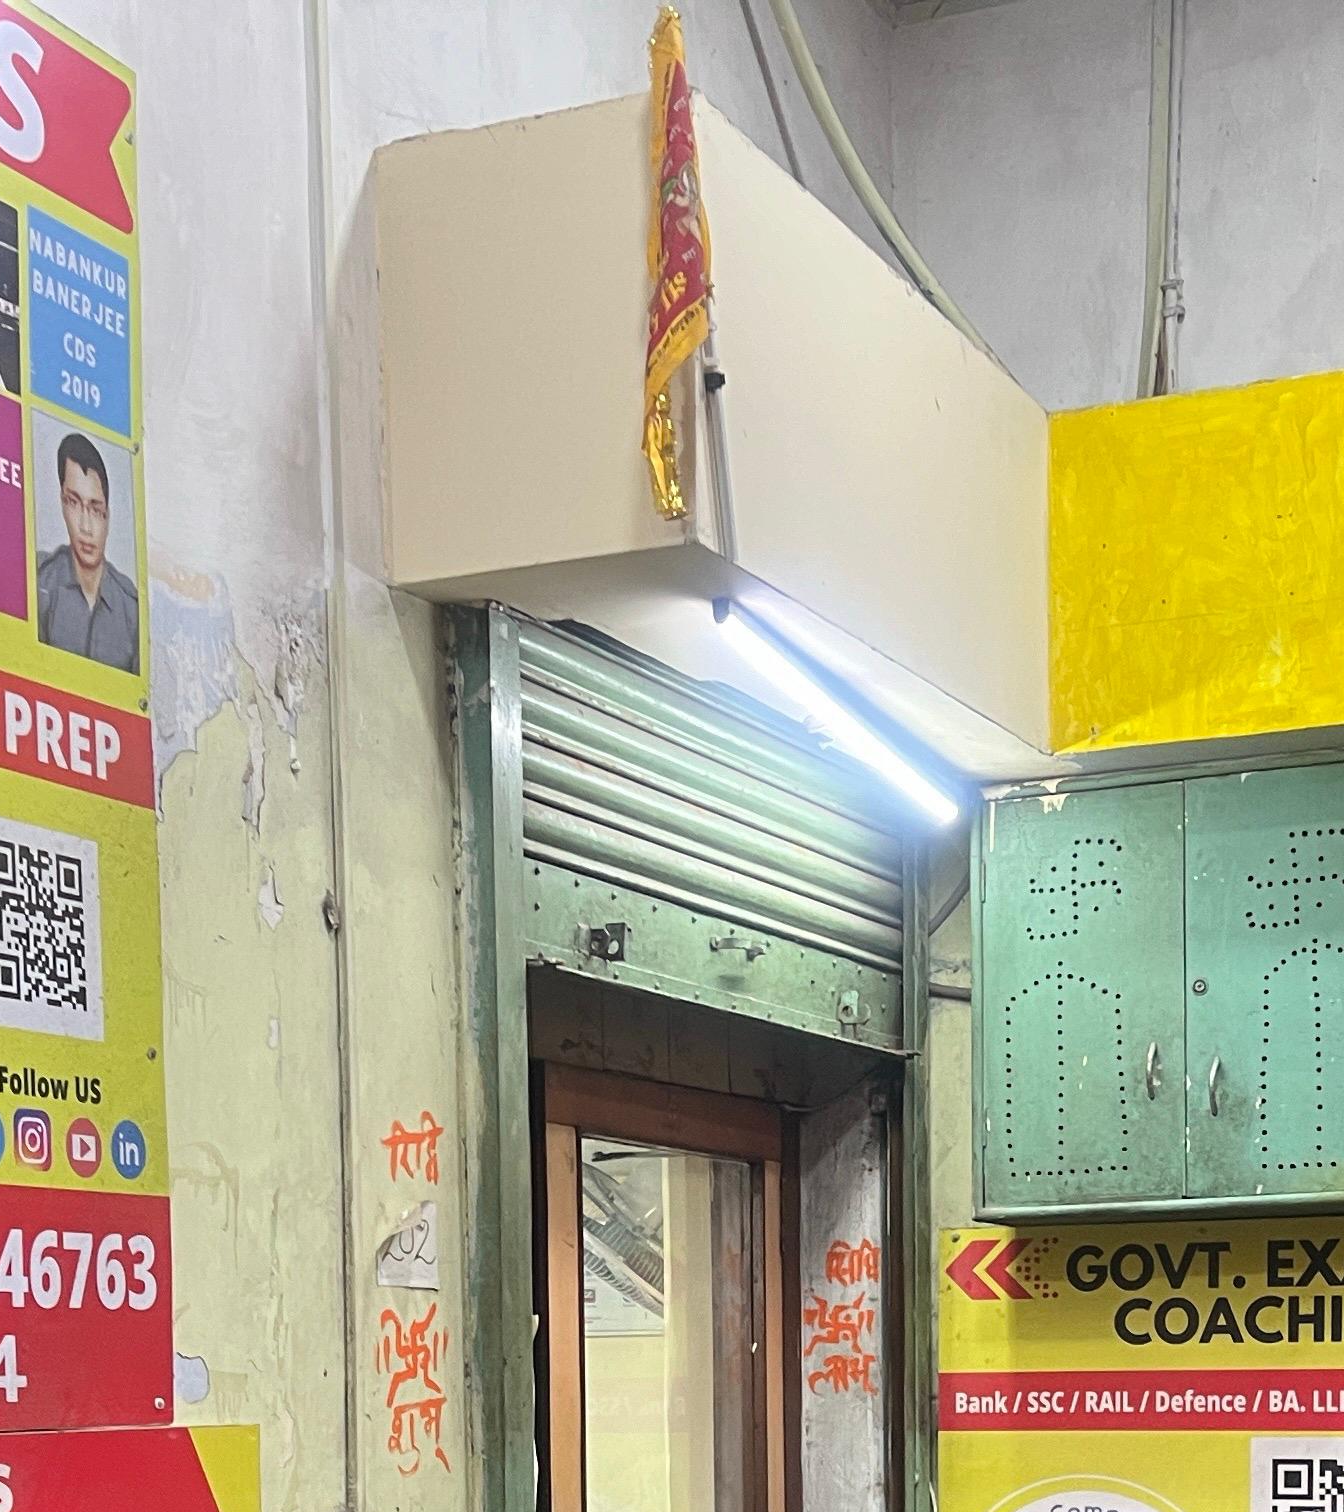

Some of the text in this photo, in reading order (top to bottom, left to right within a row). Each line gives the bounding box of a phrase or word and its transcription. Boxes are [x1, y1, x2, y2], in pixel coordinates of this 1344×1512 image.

[29, 226, 127, 300] NABANKUR
[32, 275, 126, 337] BANERJEE
[63, 333, 97, 367] CDS
[61, 370, 101, 407] 2019
[5, 687, 121, 780] PREP
[73, 1075, 102, 1104] US
[1066, 1242, 1245, 1292] GOVT.
[955, 1392, 1007, 1413] Bank
[1027, 1392, 1064, 1413] SSC
[1084, 1392, 1134, 1413] RAIL
[1155, 1391, 1246, 1413] Defence
[1269, 1391, 1305, 1413] BA.
